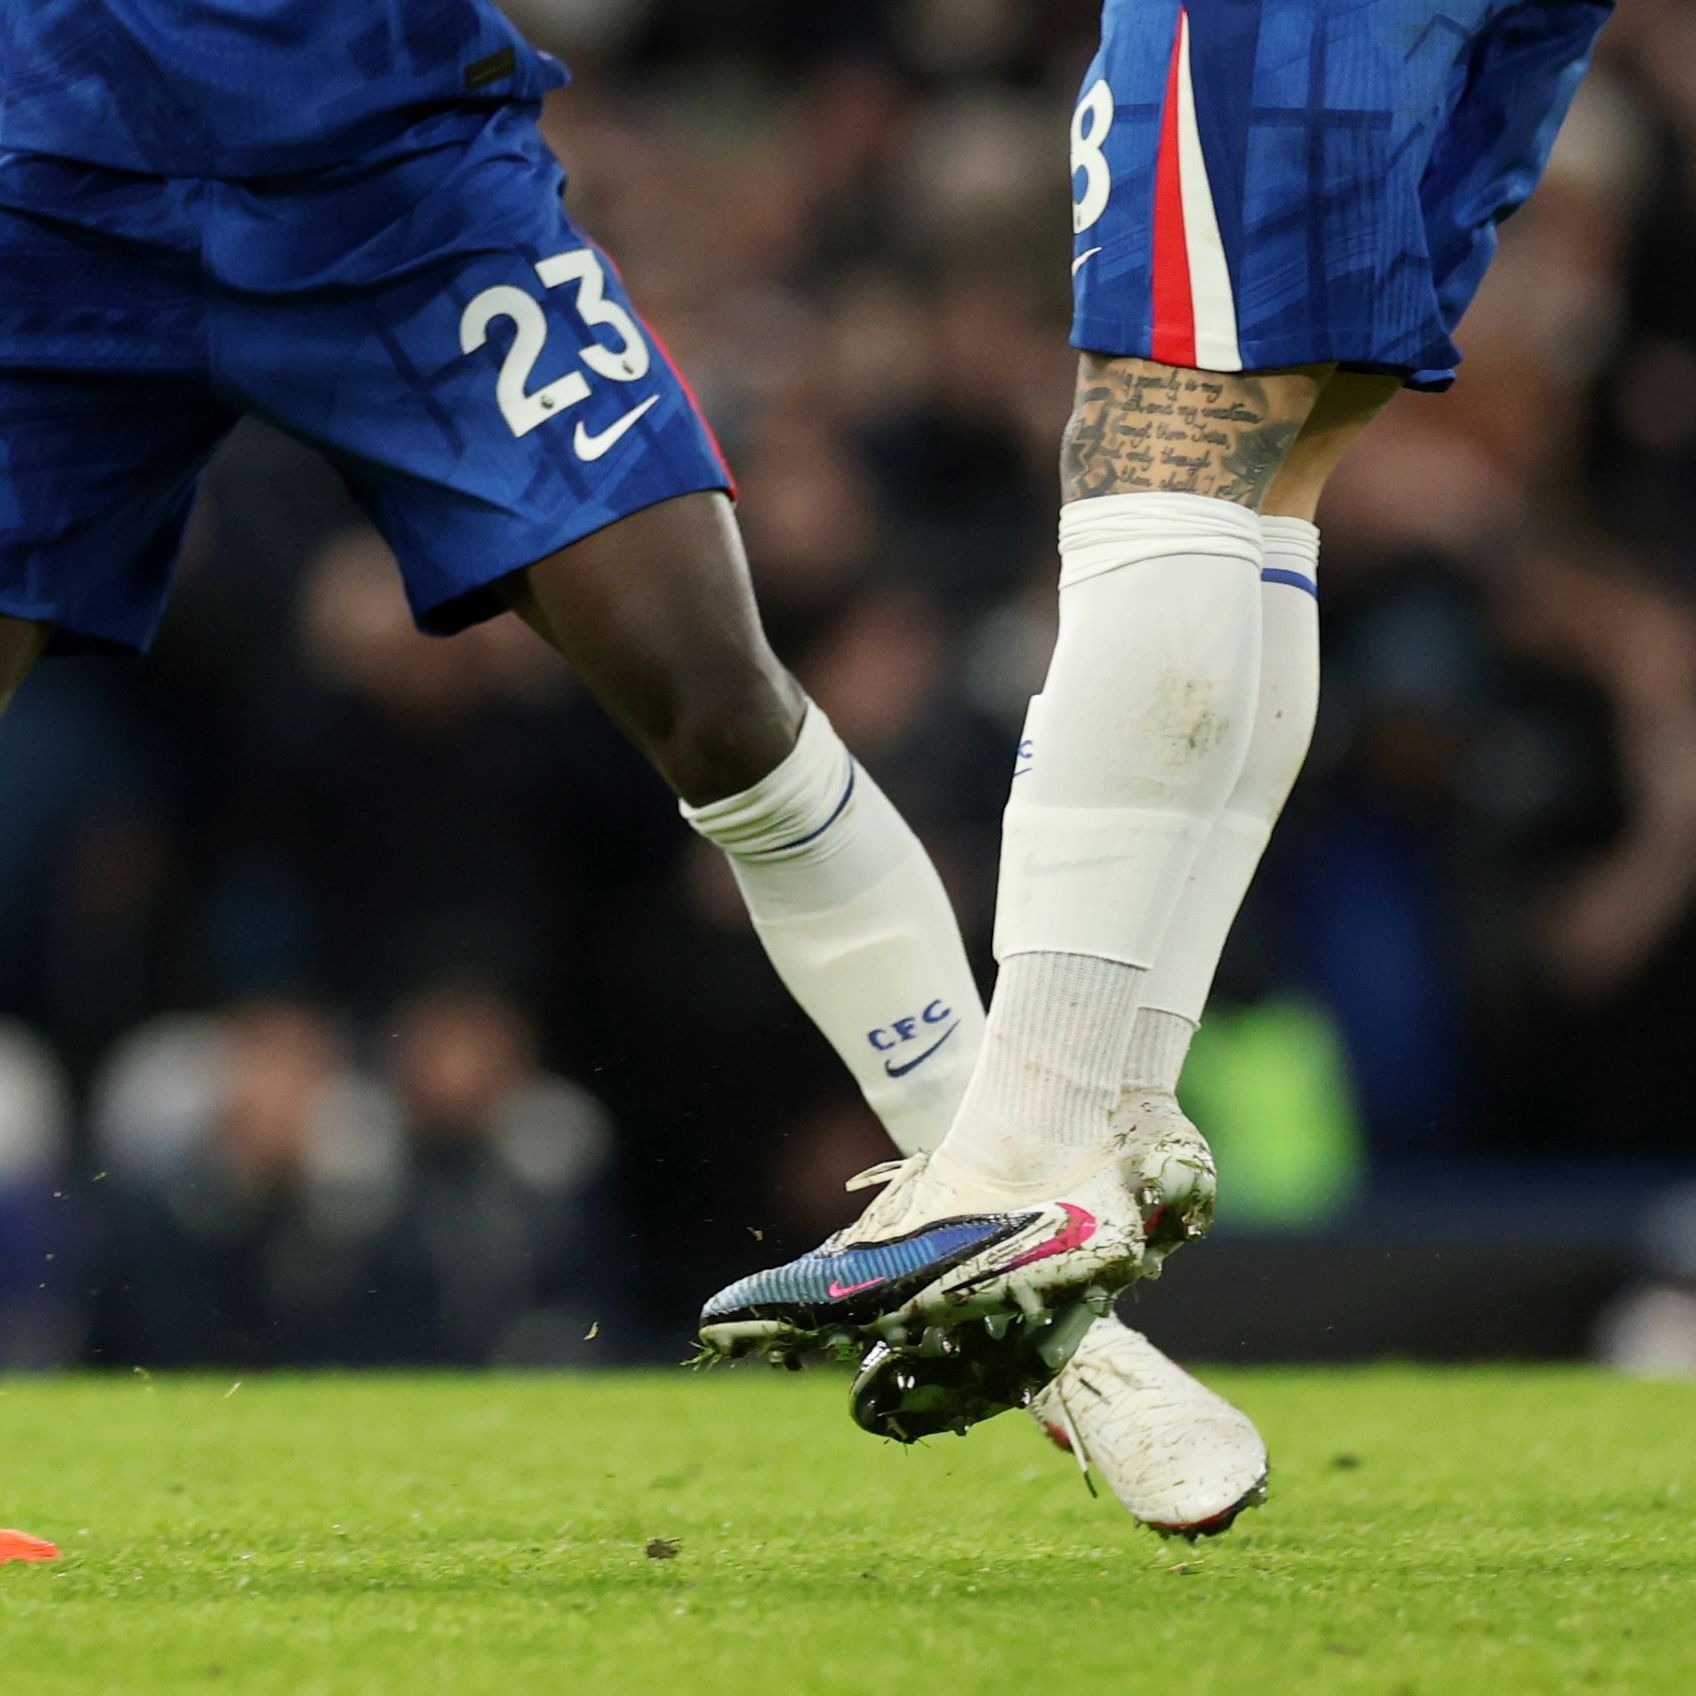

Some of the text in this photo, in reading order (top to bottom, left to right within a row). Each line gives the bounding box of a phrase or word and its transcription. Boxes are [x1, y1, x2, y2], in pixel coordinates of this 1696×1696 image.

[1070, 79, 1114, 234] 8
[460, 248, 650, 438] 23
[867, 999, 951, 1051] CFC
